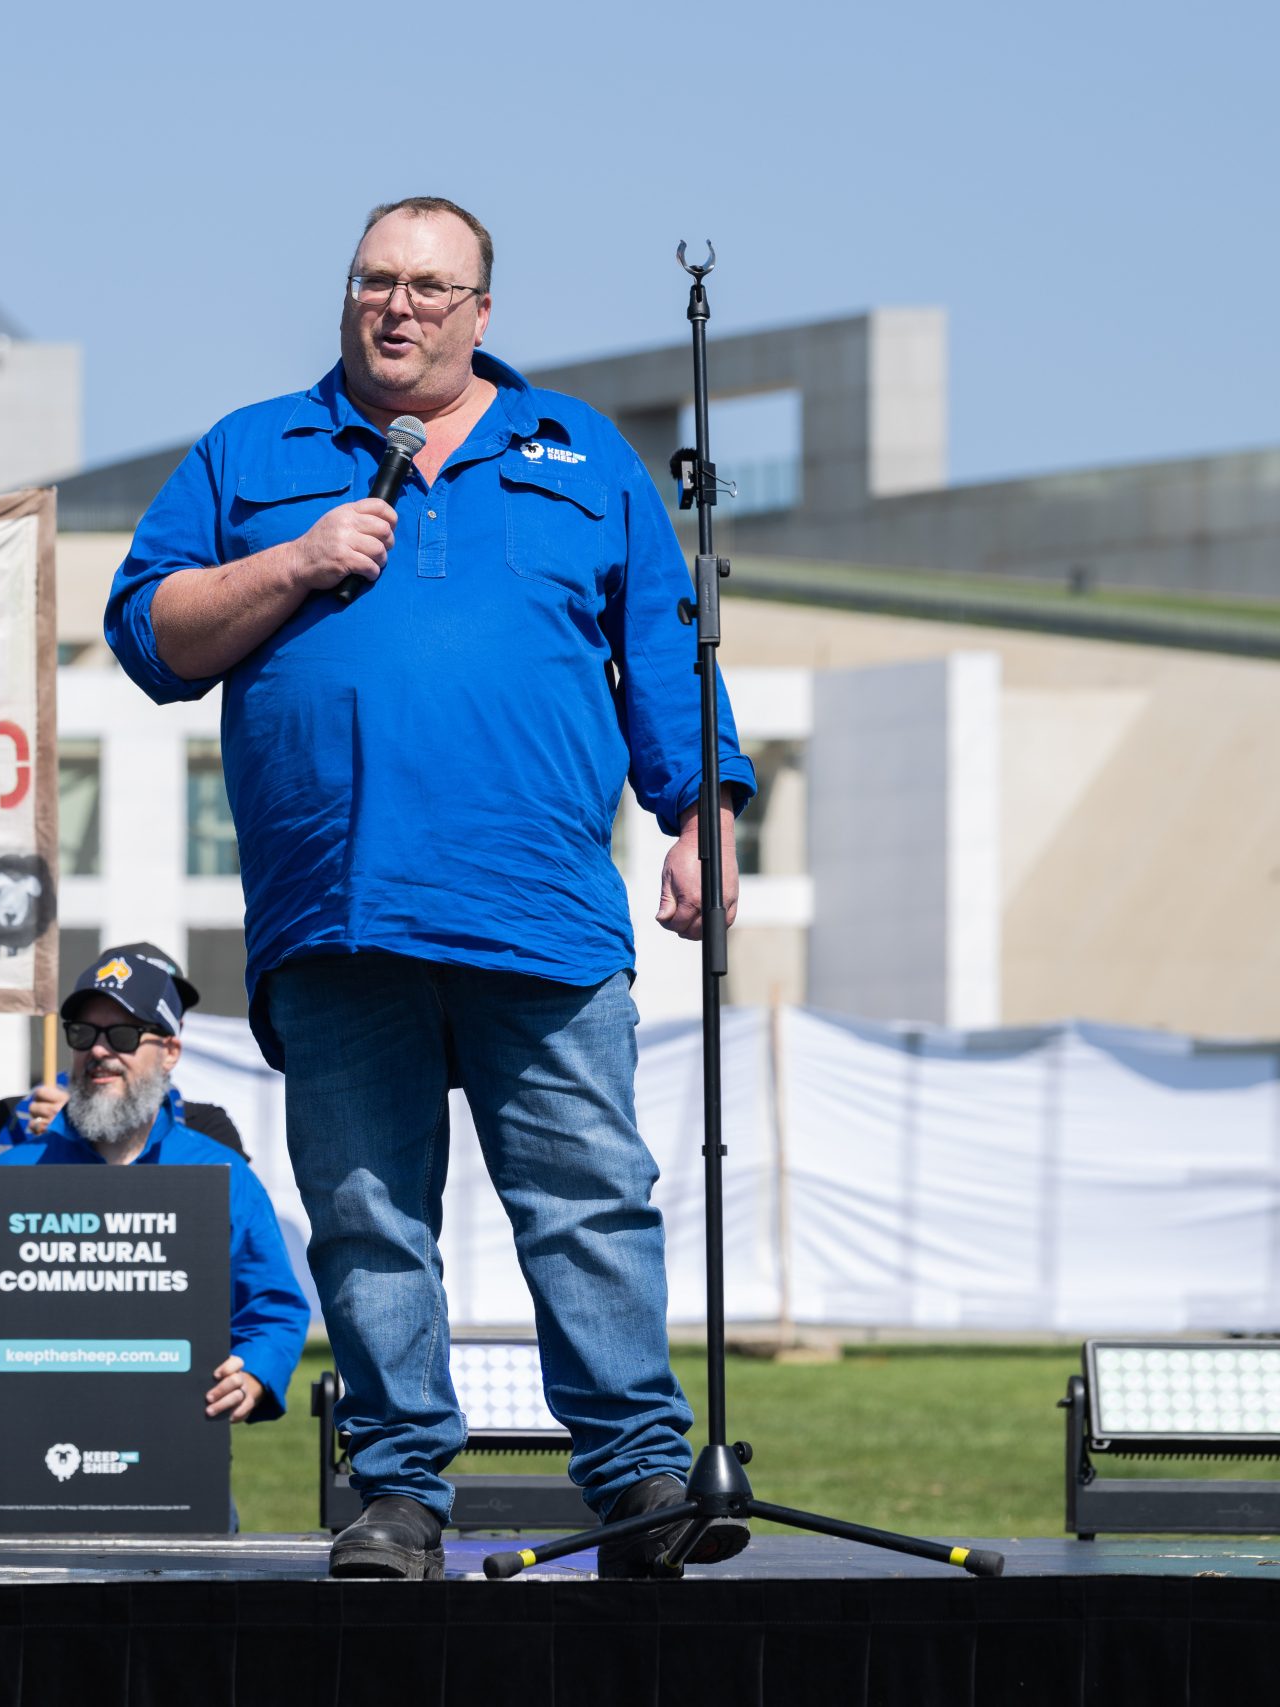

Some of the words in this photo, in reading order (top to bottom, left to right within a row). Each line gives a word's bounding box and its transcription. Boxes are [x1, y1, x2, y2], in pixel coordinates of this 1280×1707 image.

[9, 1212, 101, 1234] STAND
[104, 1212, 177, 1234] WITH
[19, 1241, 76, 1263] OUR
[79, 1241, 167, 1263] RURAL
[5, 1348, 180, 1366] keepthesheep.com.au
[82, 1450, 120, 1462] KEEP
[82, 1461, 128, 1474] SHEEP
